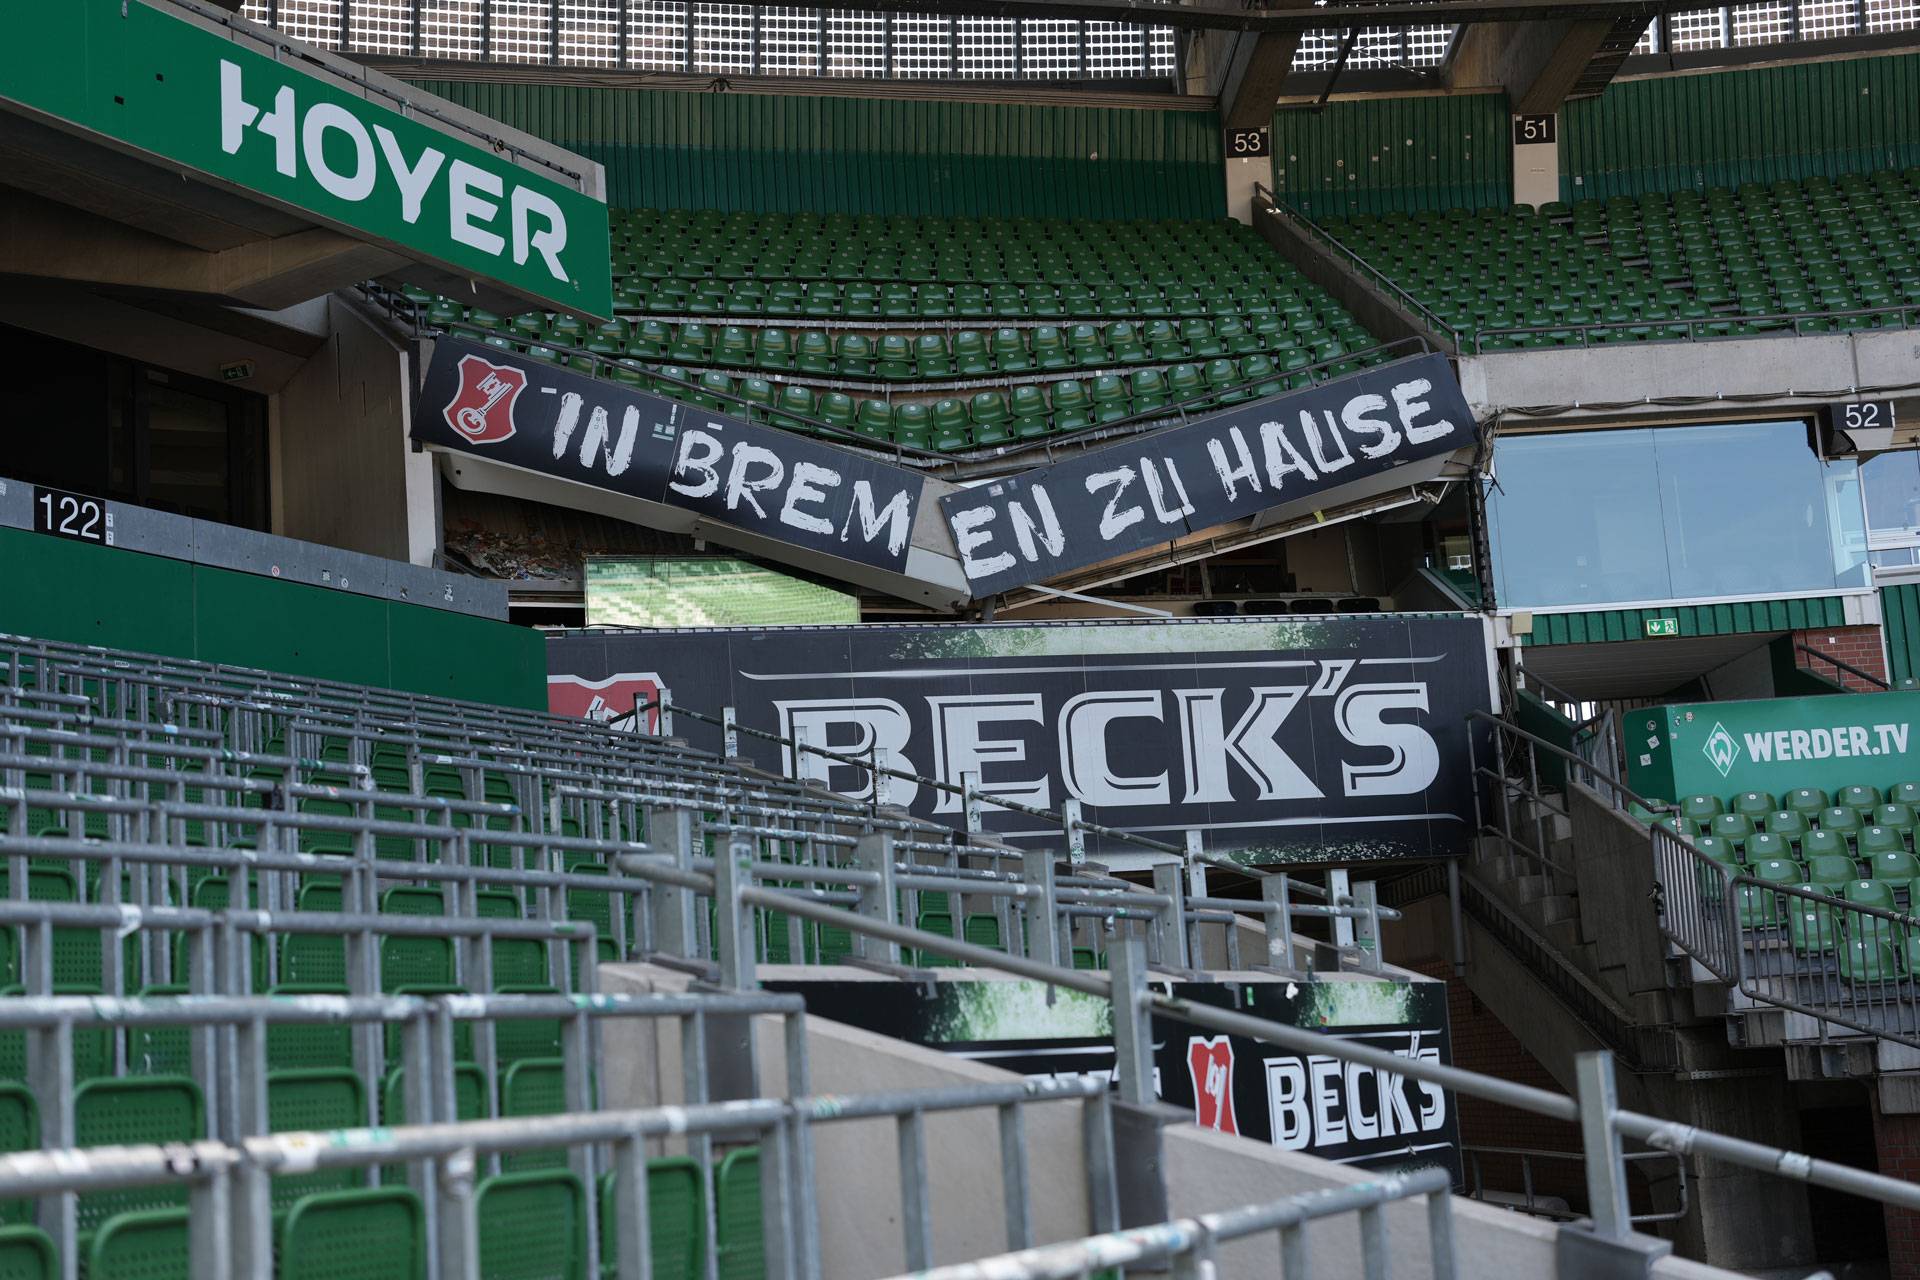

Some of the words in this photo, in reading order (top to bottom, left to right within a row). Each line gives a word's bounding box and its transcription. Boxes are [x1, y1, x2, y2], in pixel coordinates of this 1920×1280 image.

[1233, 131, 1262, 153] 53
[1524, 119, 1549, 140] 51
[220, 58, 571, 284] HOYER
[552, 391, 641, 477] IN
[1845, 403, 1880, 428] 52
[1085, 456, 1196, 541] ZU
[1206, 377, 1455, 504] HAUSE
[39, 493, 101, 540] 122
[772, 659, 1441, 815] BECK'S
[1743, 723, 1909, 763] WERDER.TV
[1263, 1030, 1446, 1151] BECK'S
